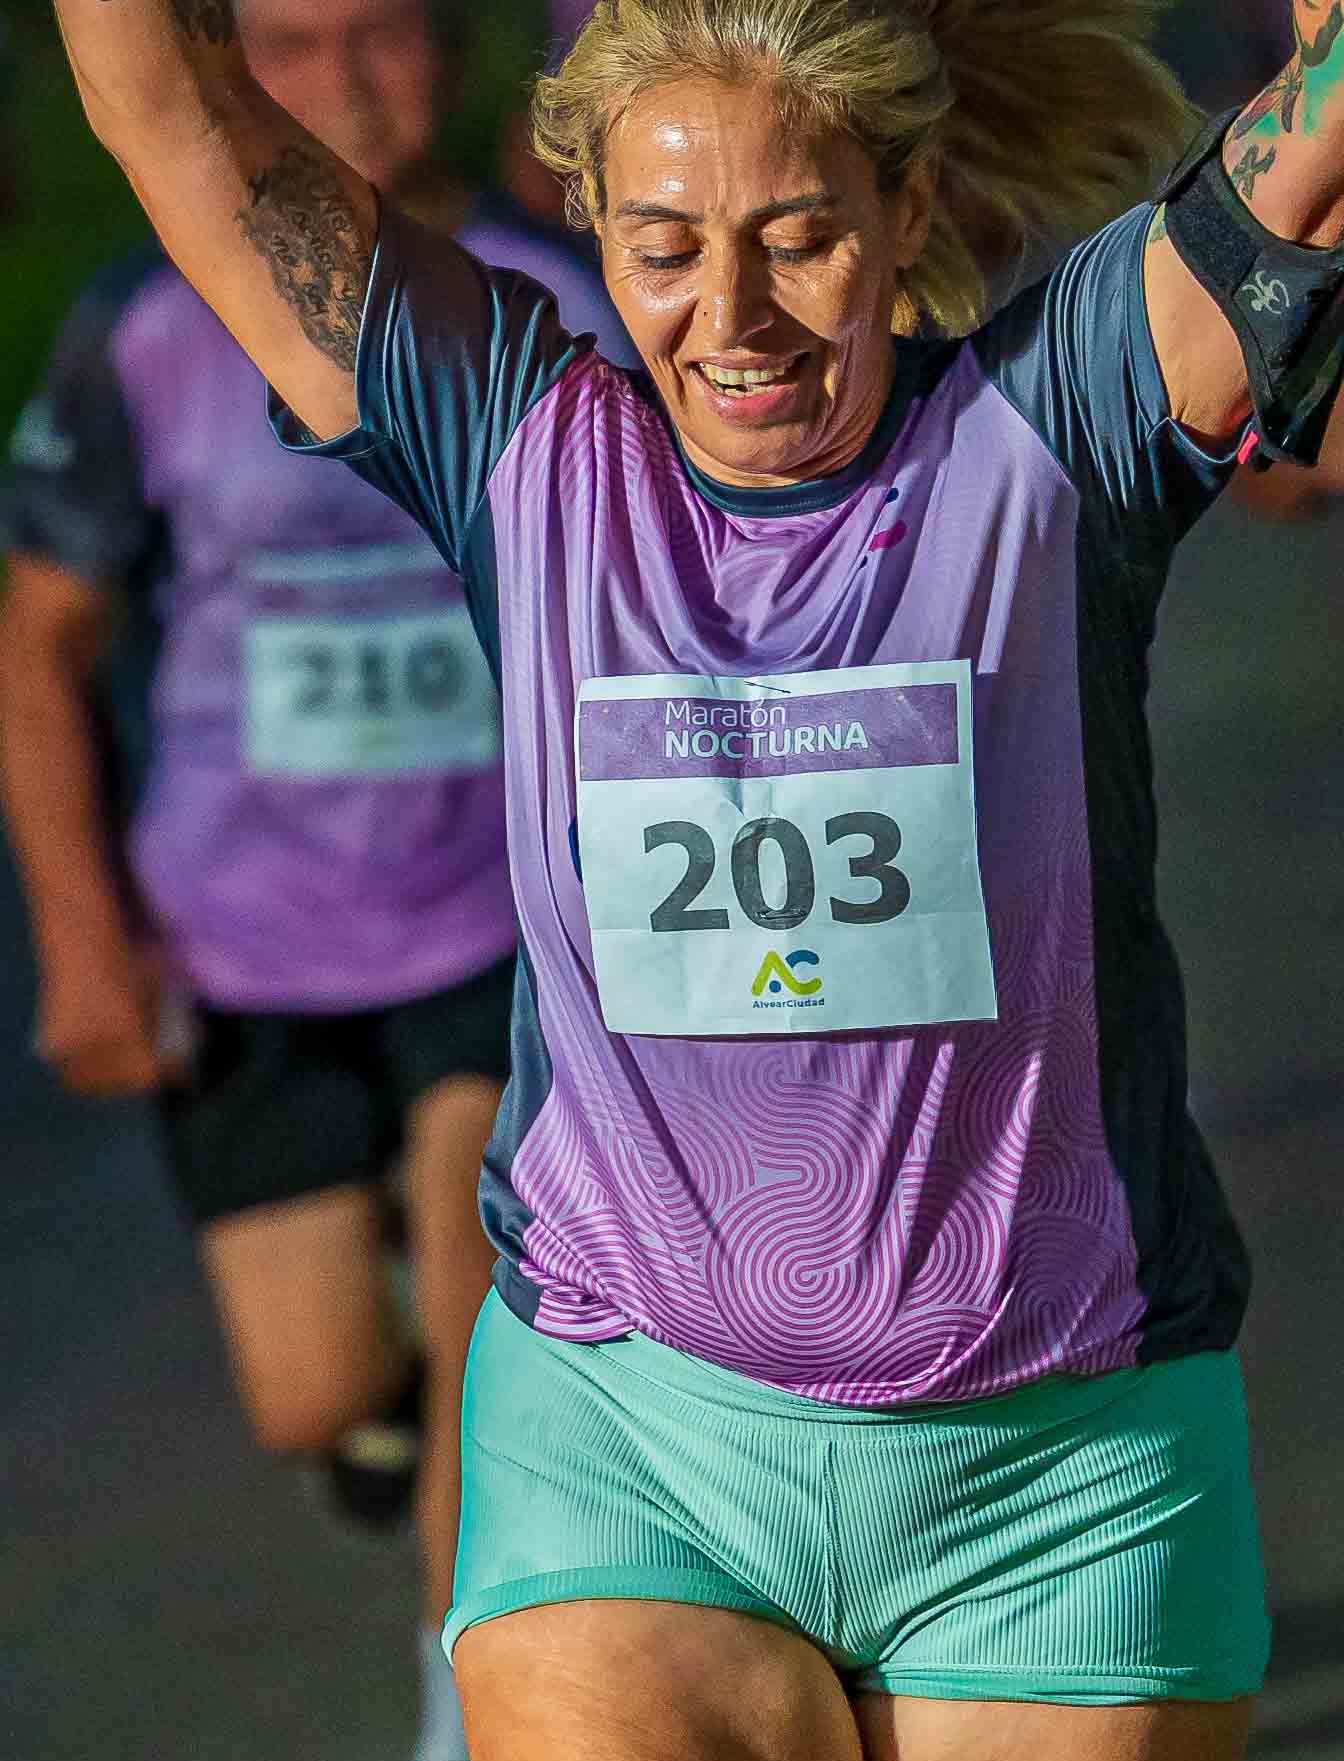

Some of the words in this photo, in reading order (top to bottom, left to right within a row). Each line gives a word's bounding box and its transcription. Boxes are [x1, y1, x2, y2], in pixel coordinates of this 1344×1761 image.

[664, 696, 786, 729] Maratón
[664, 721, 870, 759] NOCTURNA
[643, 811, 912, 933] 203
